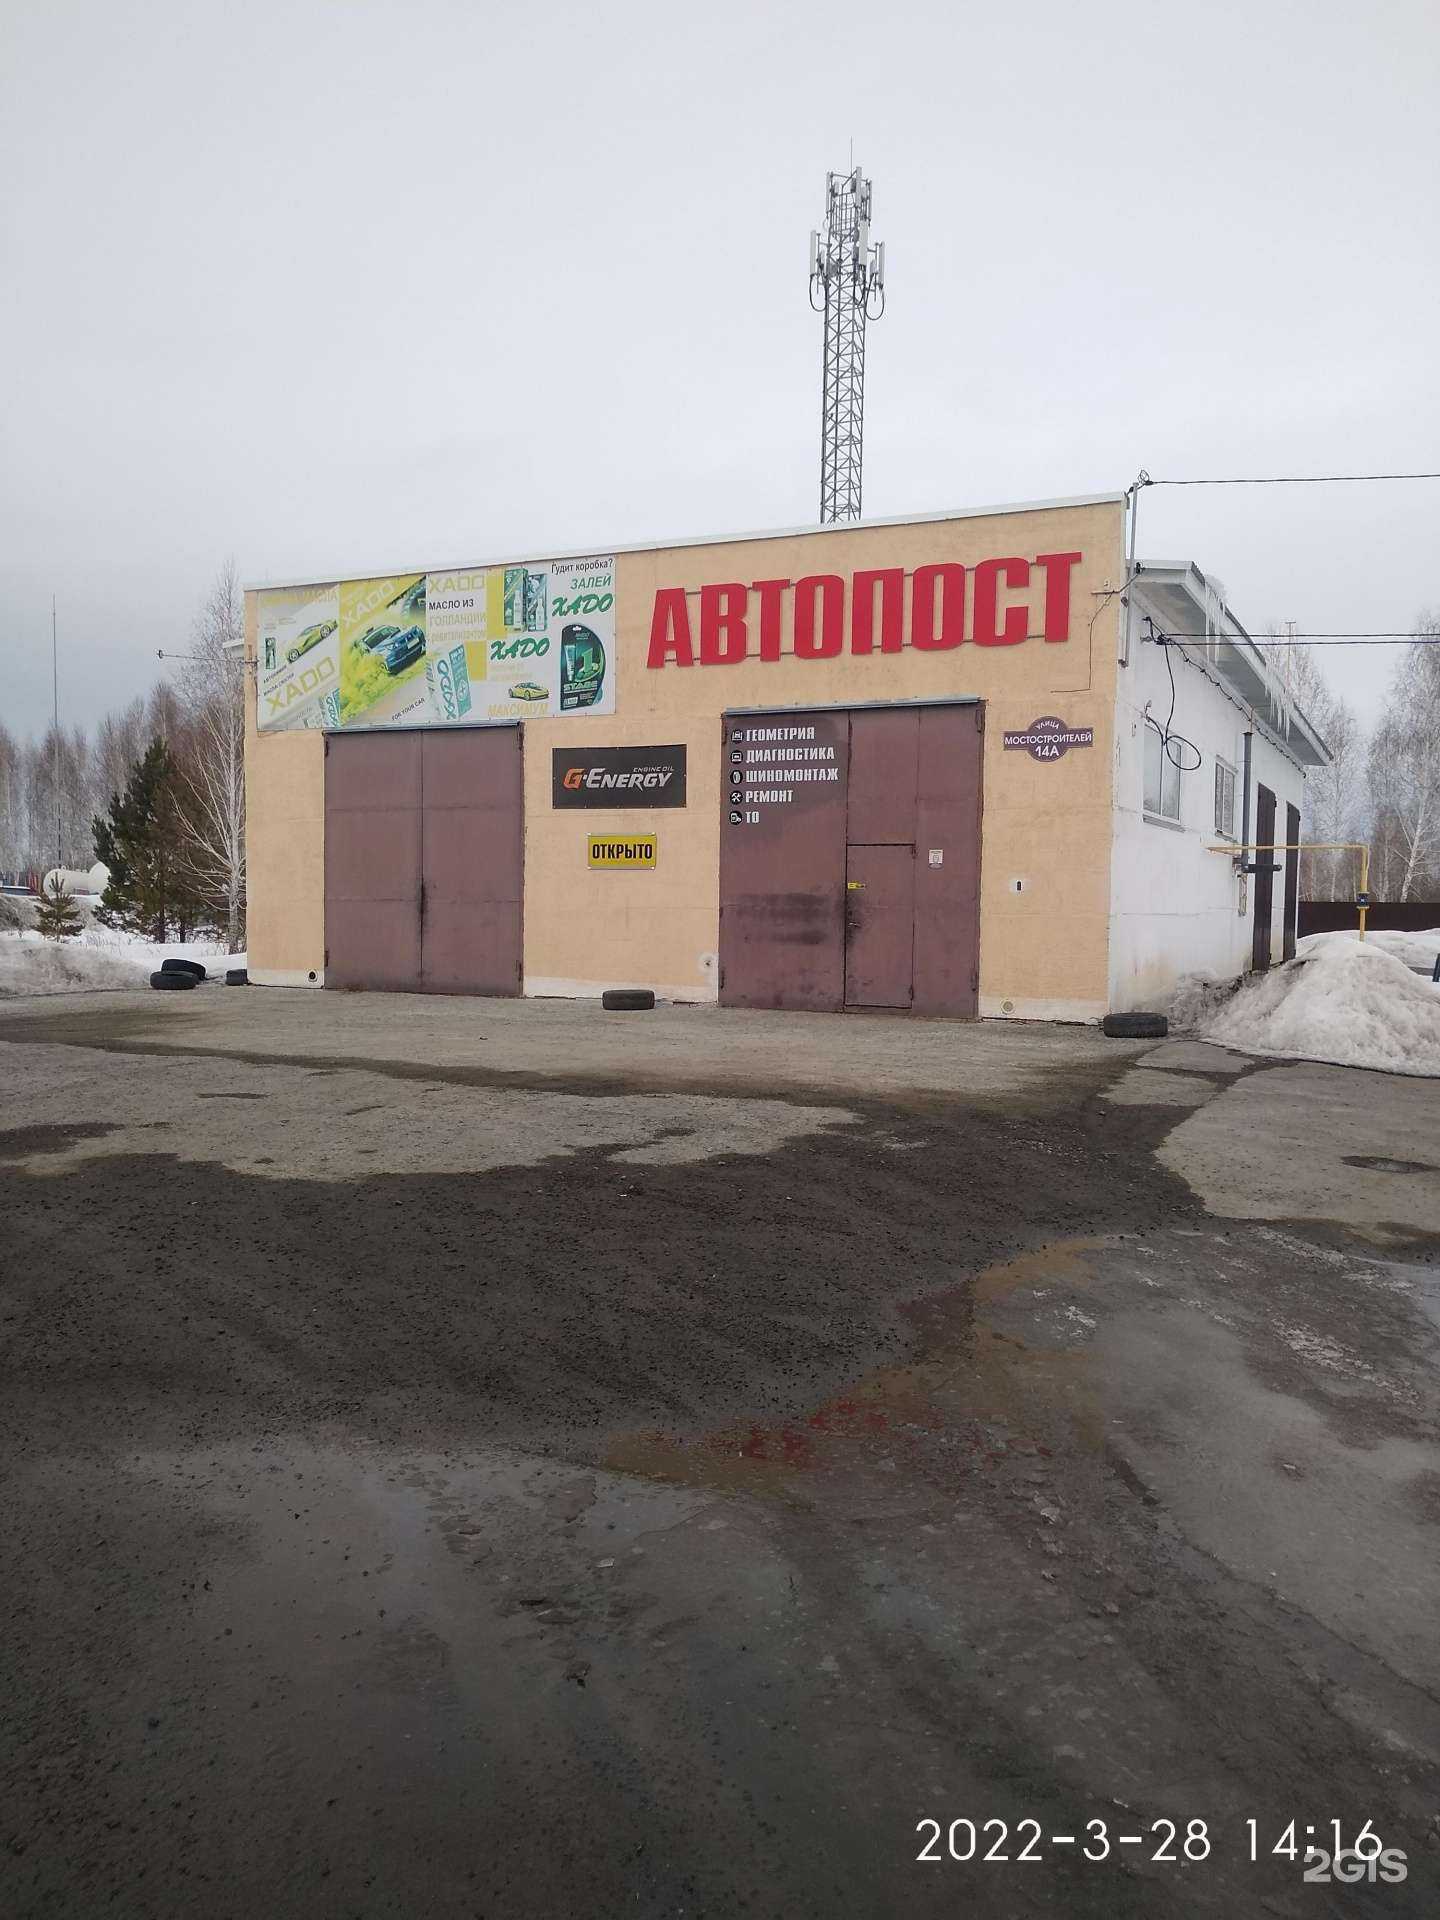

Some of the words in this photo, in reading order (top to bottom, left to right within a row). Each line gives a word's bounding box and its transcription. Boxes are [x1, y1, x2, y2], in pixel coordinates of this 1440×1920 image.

[551, 561, 573, 575] Гудит
[576, 558, 613, 572] коробка?
[571, 573, 612, 590] ЗАЛЕЙ
[428, 600, 460, 611] МАСЛО
[462, 598, 474, 609] ИЗ
[551, 593, 613, 617] XADO
[647, 552, 1082, 669] АВТОПОСТ
[490, 637, 550, 661] XADO
[1035, 720, 1060, 730] УЛИЦА
[746, 726, 815, 741] ГЕОМЕТРИЯ
[1004, 732, 1092, 745] МОСТОСТРОИТЕЛЕЙ
[746, 747, 835, 763] ДИАГНОСТИКА
[1035, 745, 1060, 757] 14А
[745, 768, 839, 783] ШИНОМОНТАЖ
[745, 790, 793, 803] РЕМОНТ
[745, 811, 760, 823] ТО
[592, 844, 653, 859] ОТКРЫТО
